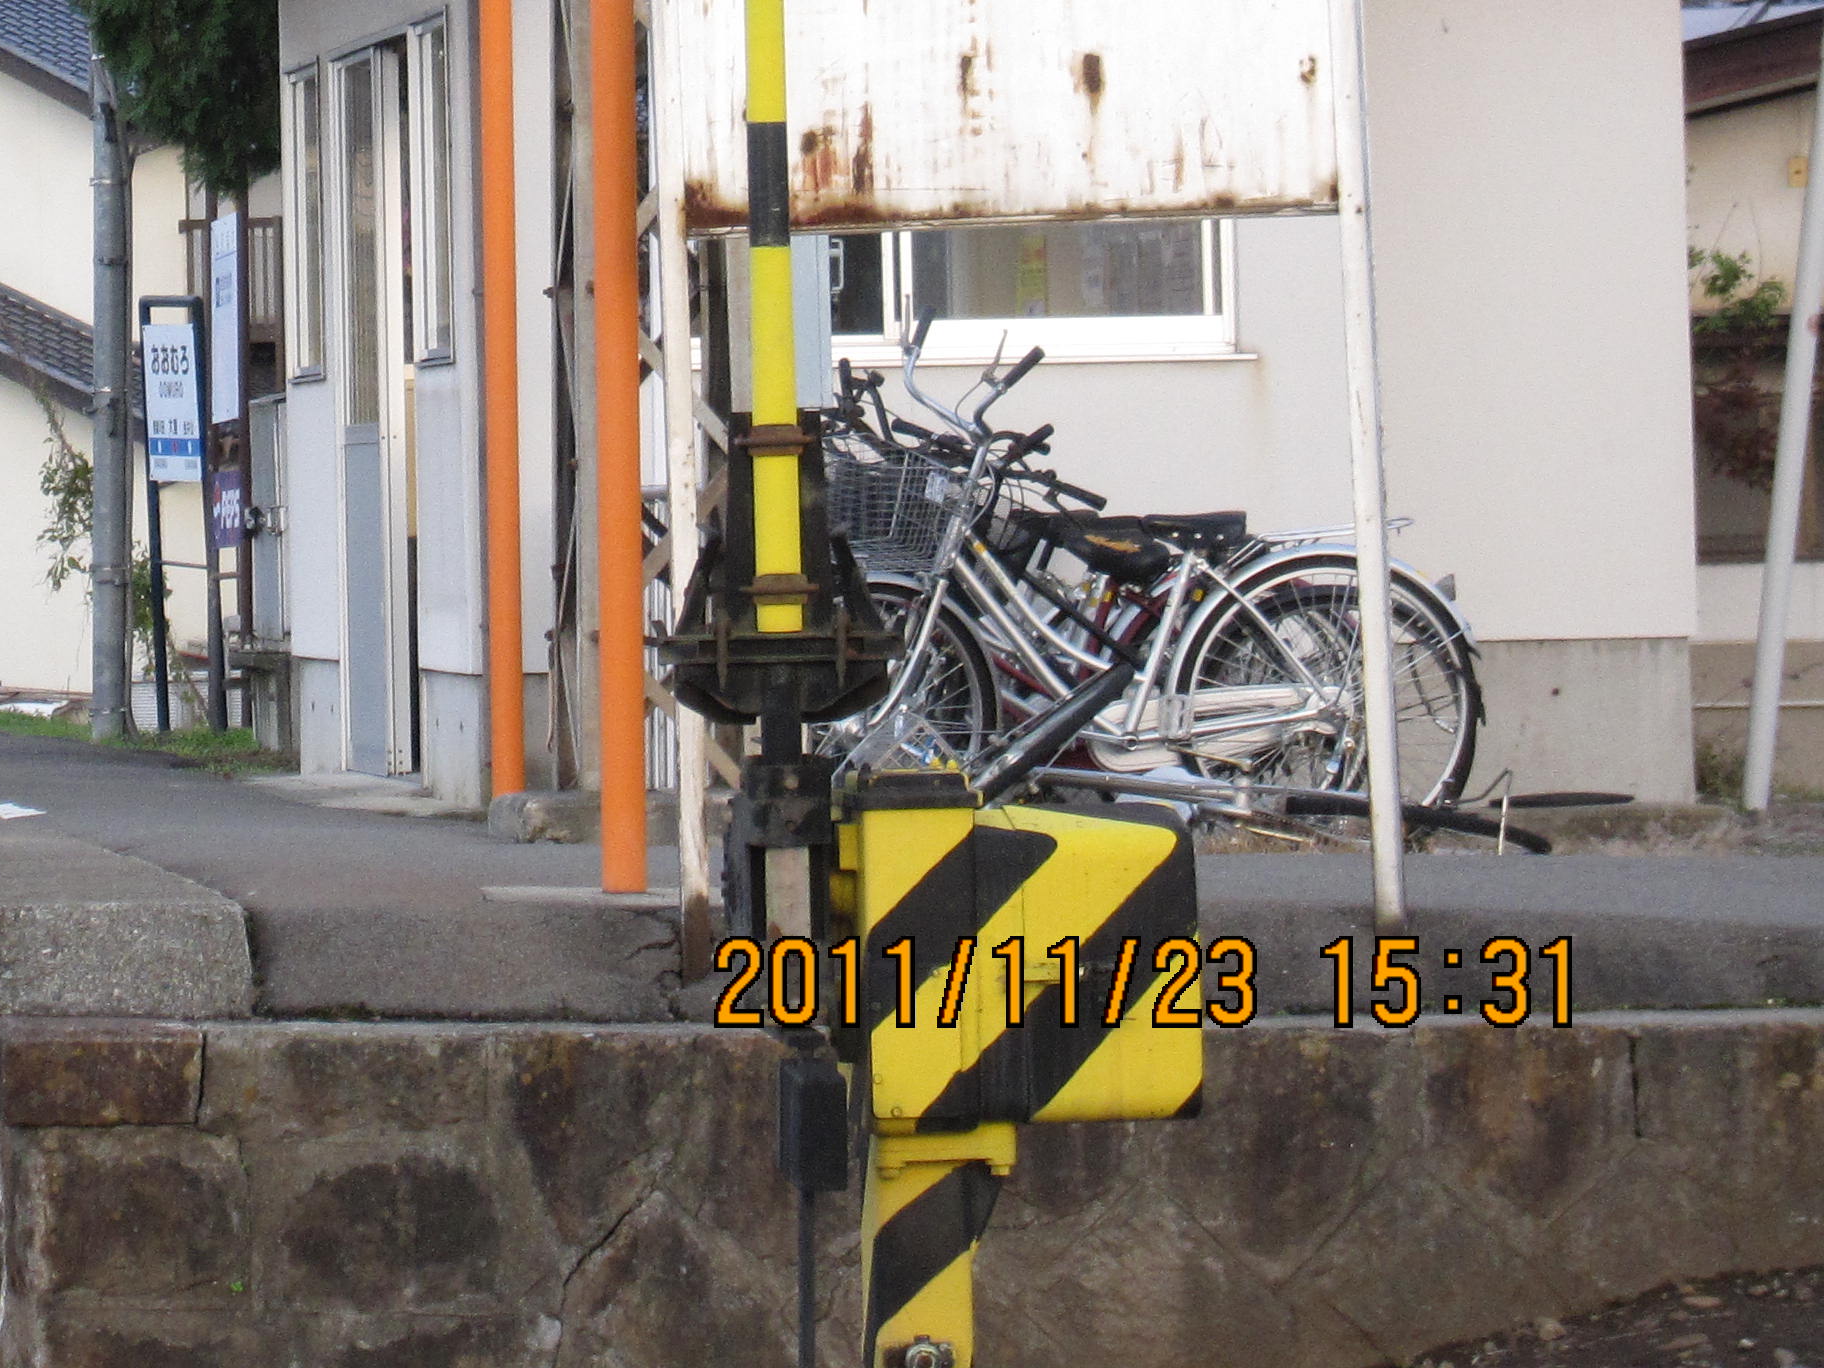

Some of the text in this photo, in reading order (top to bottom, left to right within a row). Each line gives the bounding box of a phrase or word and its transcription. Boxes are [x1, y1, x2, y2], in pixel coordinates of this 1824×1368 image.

[150, 343, 190, 376] おおむろ
[221, 486, 240, 529] PEPS
